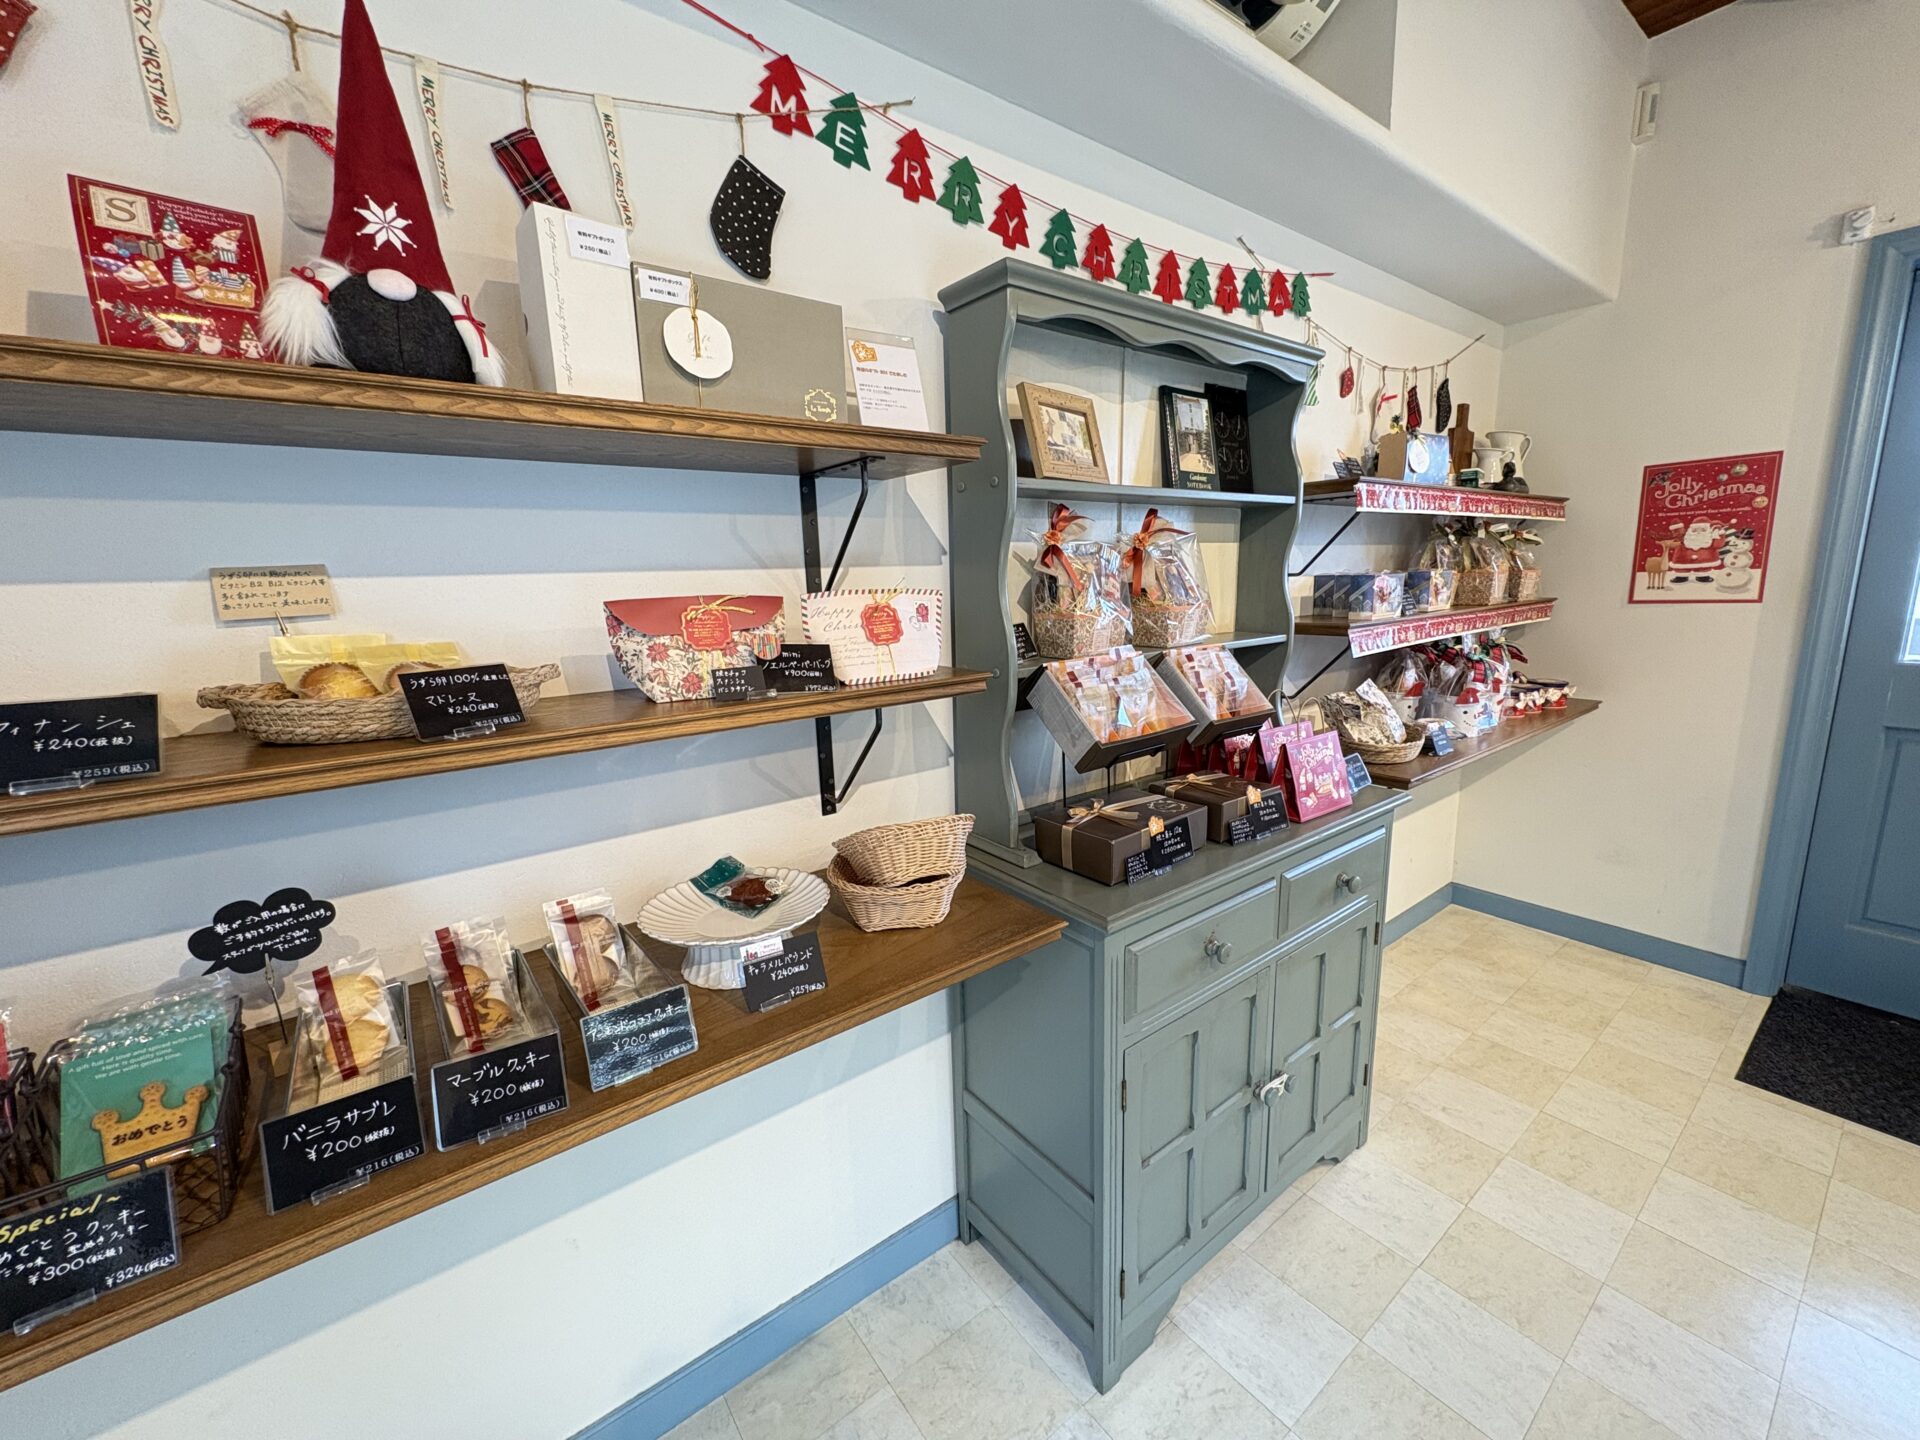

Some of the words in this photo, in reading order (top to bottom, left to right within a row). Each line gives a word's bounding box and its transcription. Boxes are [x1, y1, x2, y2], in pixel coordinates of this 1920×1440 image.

[138, 34, 174, 125] CHRISTMAS
[421, 75, 439, 130] MERRY
[431, 131, 451, 204] CHRISTMAS
[601, 112, 619, 158] MERRY
[612, 162, 634, 227] CHRISTMAS
[104, 197, 137, 222] S
[770, 84, 1020, 237] MERRY
[1052, 234, 1307, 308] CHRISTMAS
[1654, 476, 1703, 499] Jolly
[1665, 483, 1766, 508] Christmas
[425, 691, 482, 707] マドレーヌ
[748, 946, 814, 977] キャラメルパウンド
[446, 1051, 551, 1088] マーブルクッキー
[111, 1114, 188, 1147] おめでとう
[282, 1099, 397, 1150] バニラサブレ
